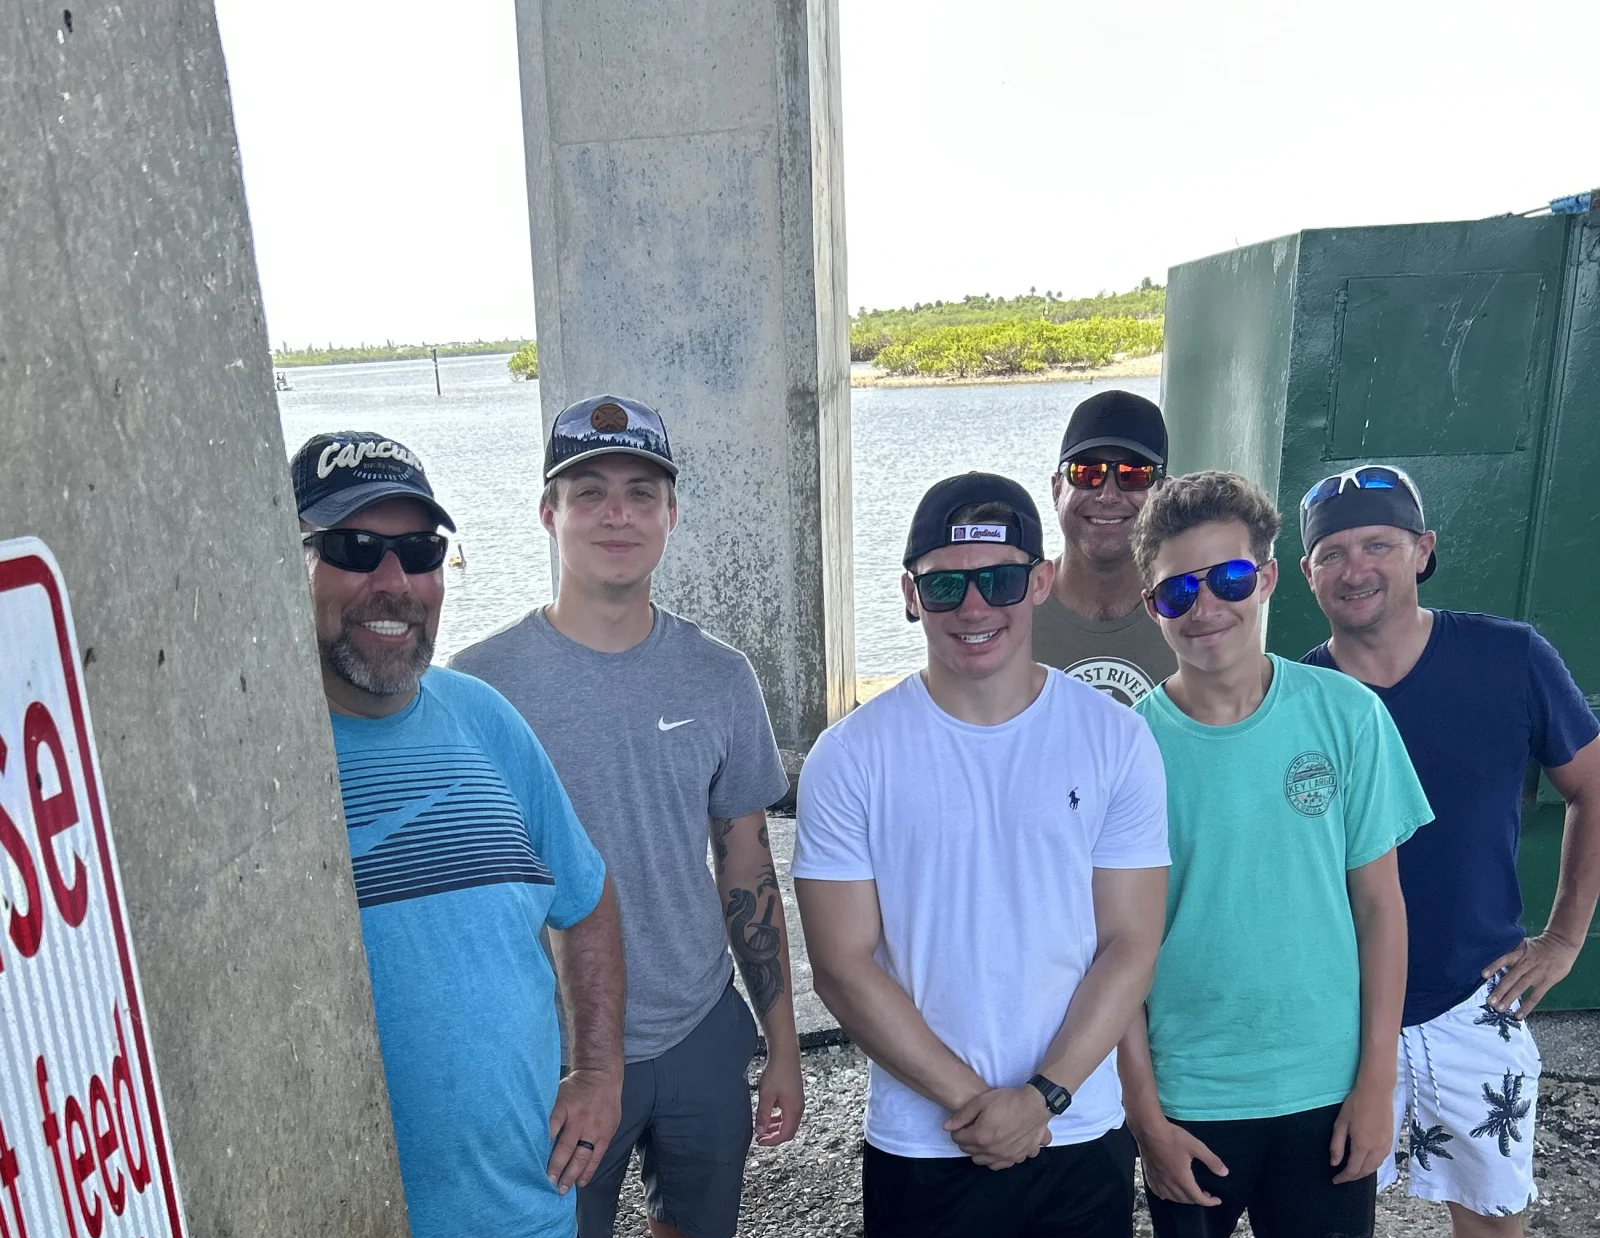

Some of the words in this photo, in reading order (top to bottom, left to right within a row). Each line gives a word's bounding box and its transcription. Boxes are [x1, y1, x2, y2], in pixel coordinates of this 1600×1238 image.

[317, 440, 423, 479] Cancun
[970, 526, 1001, 539] Cardinals
[1288, 782, 1305, 793] KEY
[1309, 776, 1334, 788] LARGO
[0, 700, 88, 958] se
